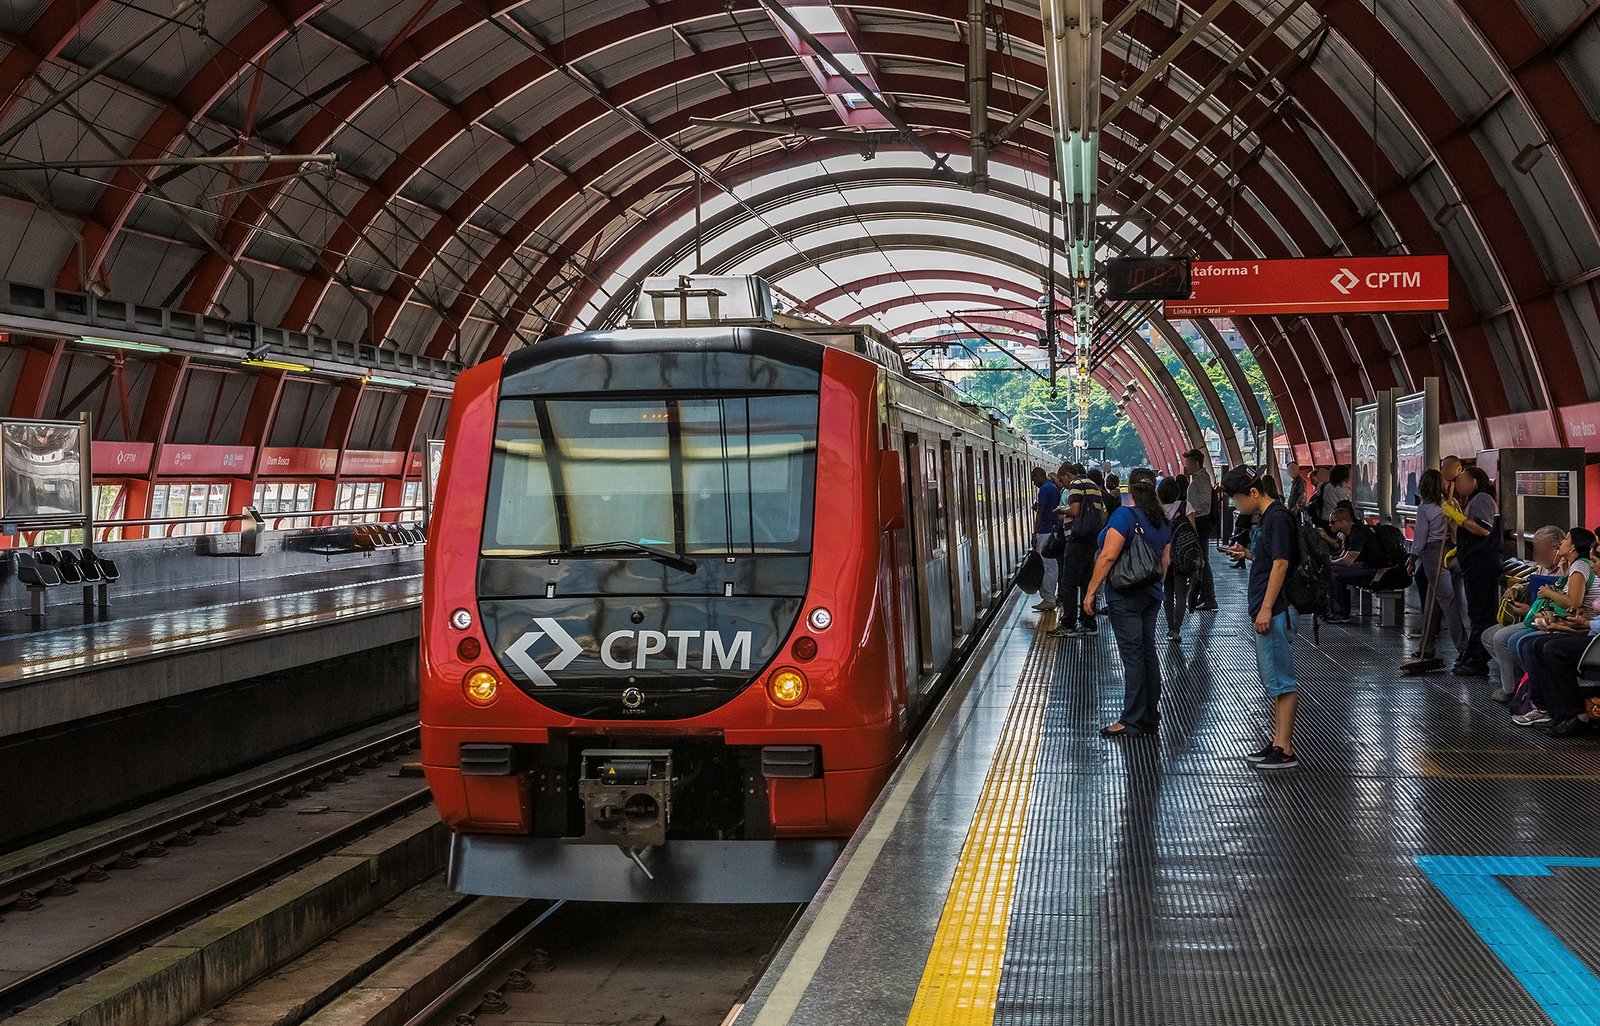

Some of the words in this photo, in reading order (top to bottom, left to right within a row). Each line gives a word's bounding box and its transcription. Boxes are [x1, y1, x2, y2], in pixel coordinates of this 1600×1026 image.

[1253, 265, 1259, 275] 1
[1365, 272, 1420, 288] CPTM
[600, 629, 752, 670] CPTM
